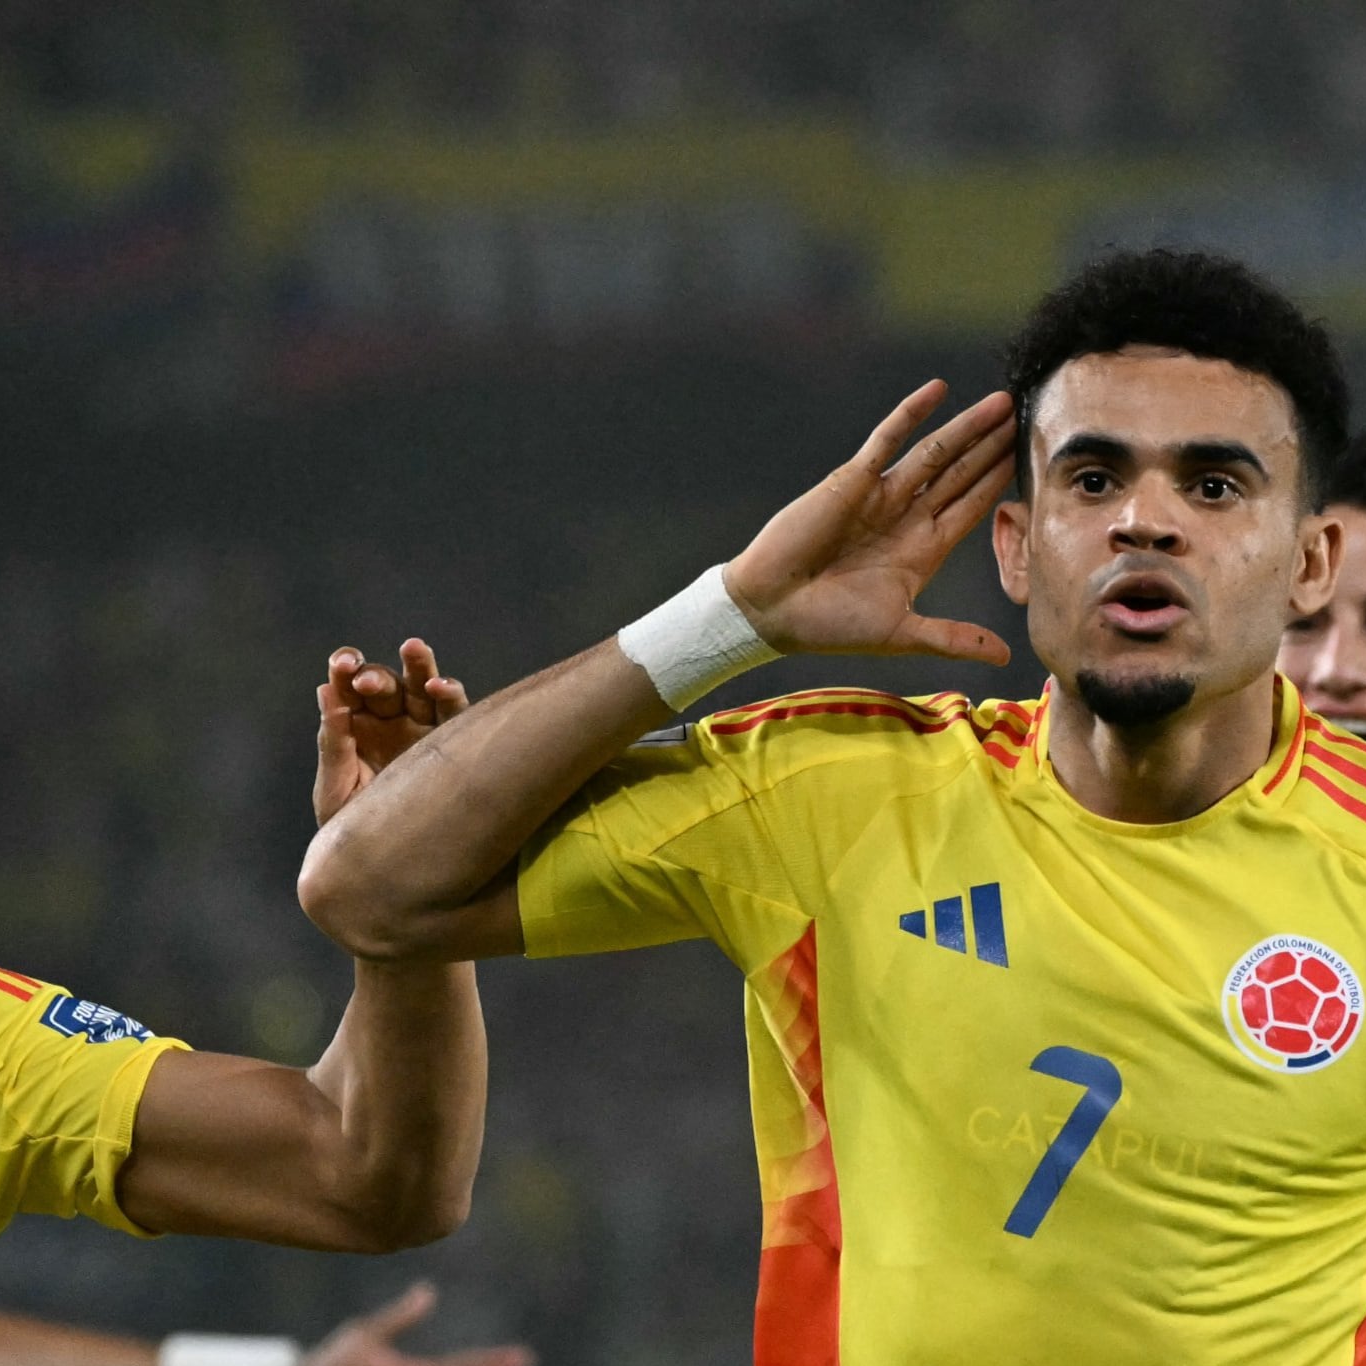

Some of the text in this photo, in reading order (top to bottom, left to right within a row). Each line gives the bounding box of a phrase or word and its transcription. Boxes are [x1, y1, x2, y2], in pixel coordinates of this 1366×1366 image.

[1272, 938, 1336, 964] COLOMBIANA
[1334, 961, 1347, 973] DE
[1003, 1046, 1122, 1239] 7
